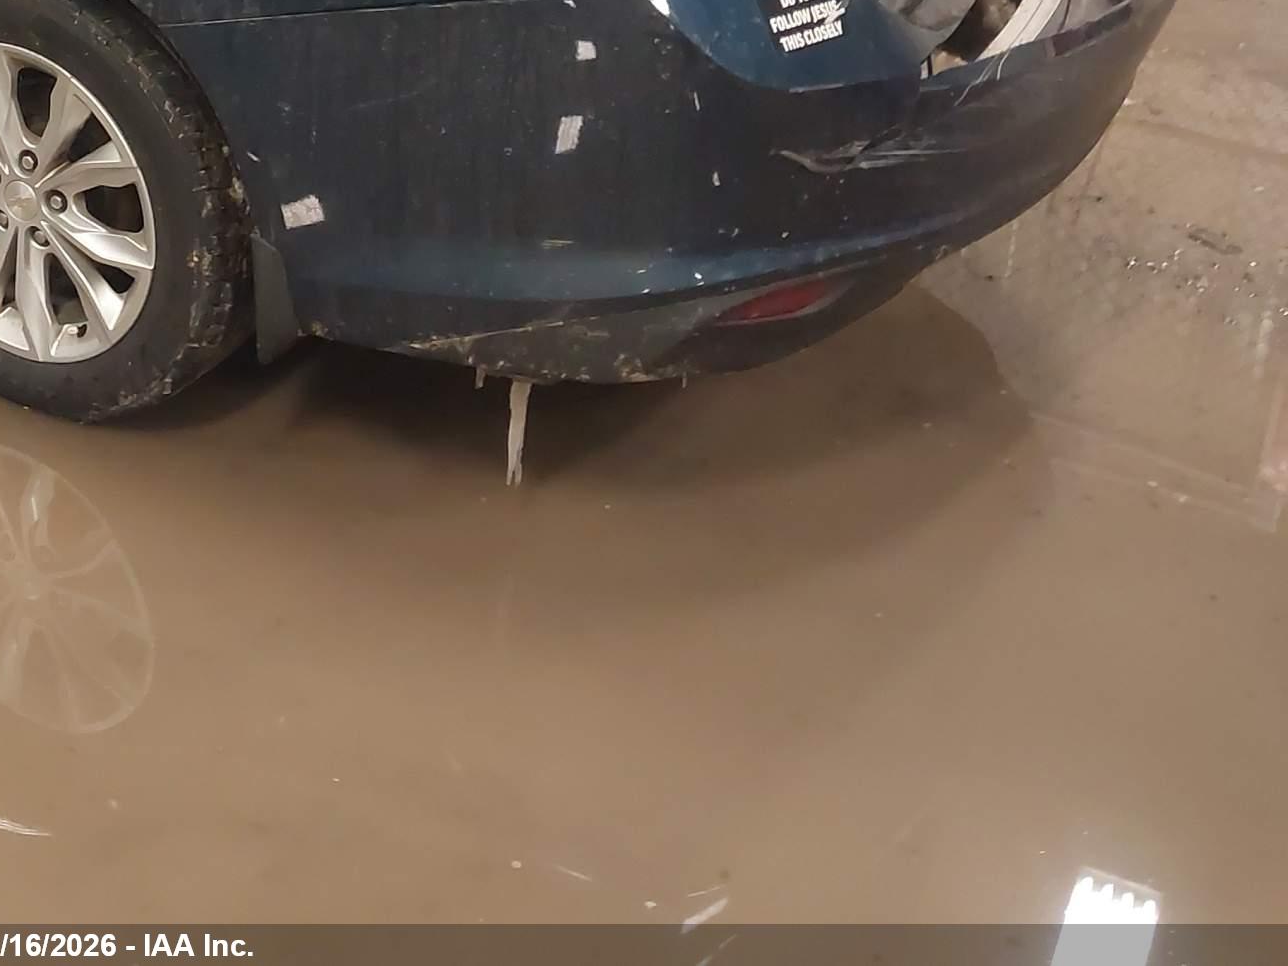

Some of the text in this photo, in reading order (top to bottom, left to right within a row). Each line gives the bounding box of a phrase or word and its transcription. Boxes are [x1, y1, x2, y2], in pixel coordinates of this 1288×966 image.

[770, 8, 812, 33] FOLLOW
[780, 20, 843, 52] THIS CLOSELY
